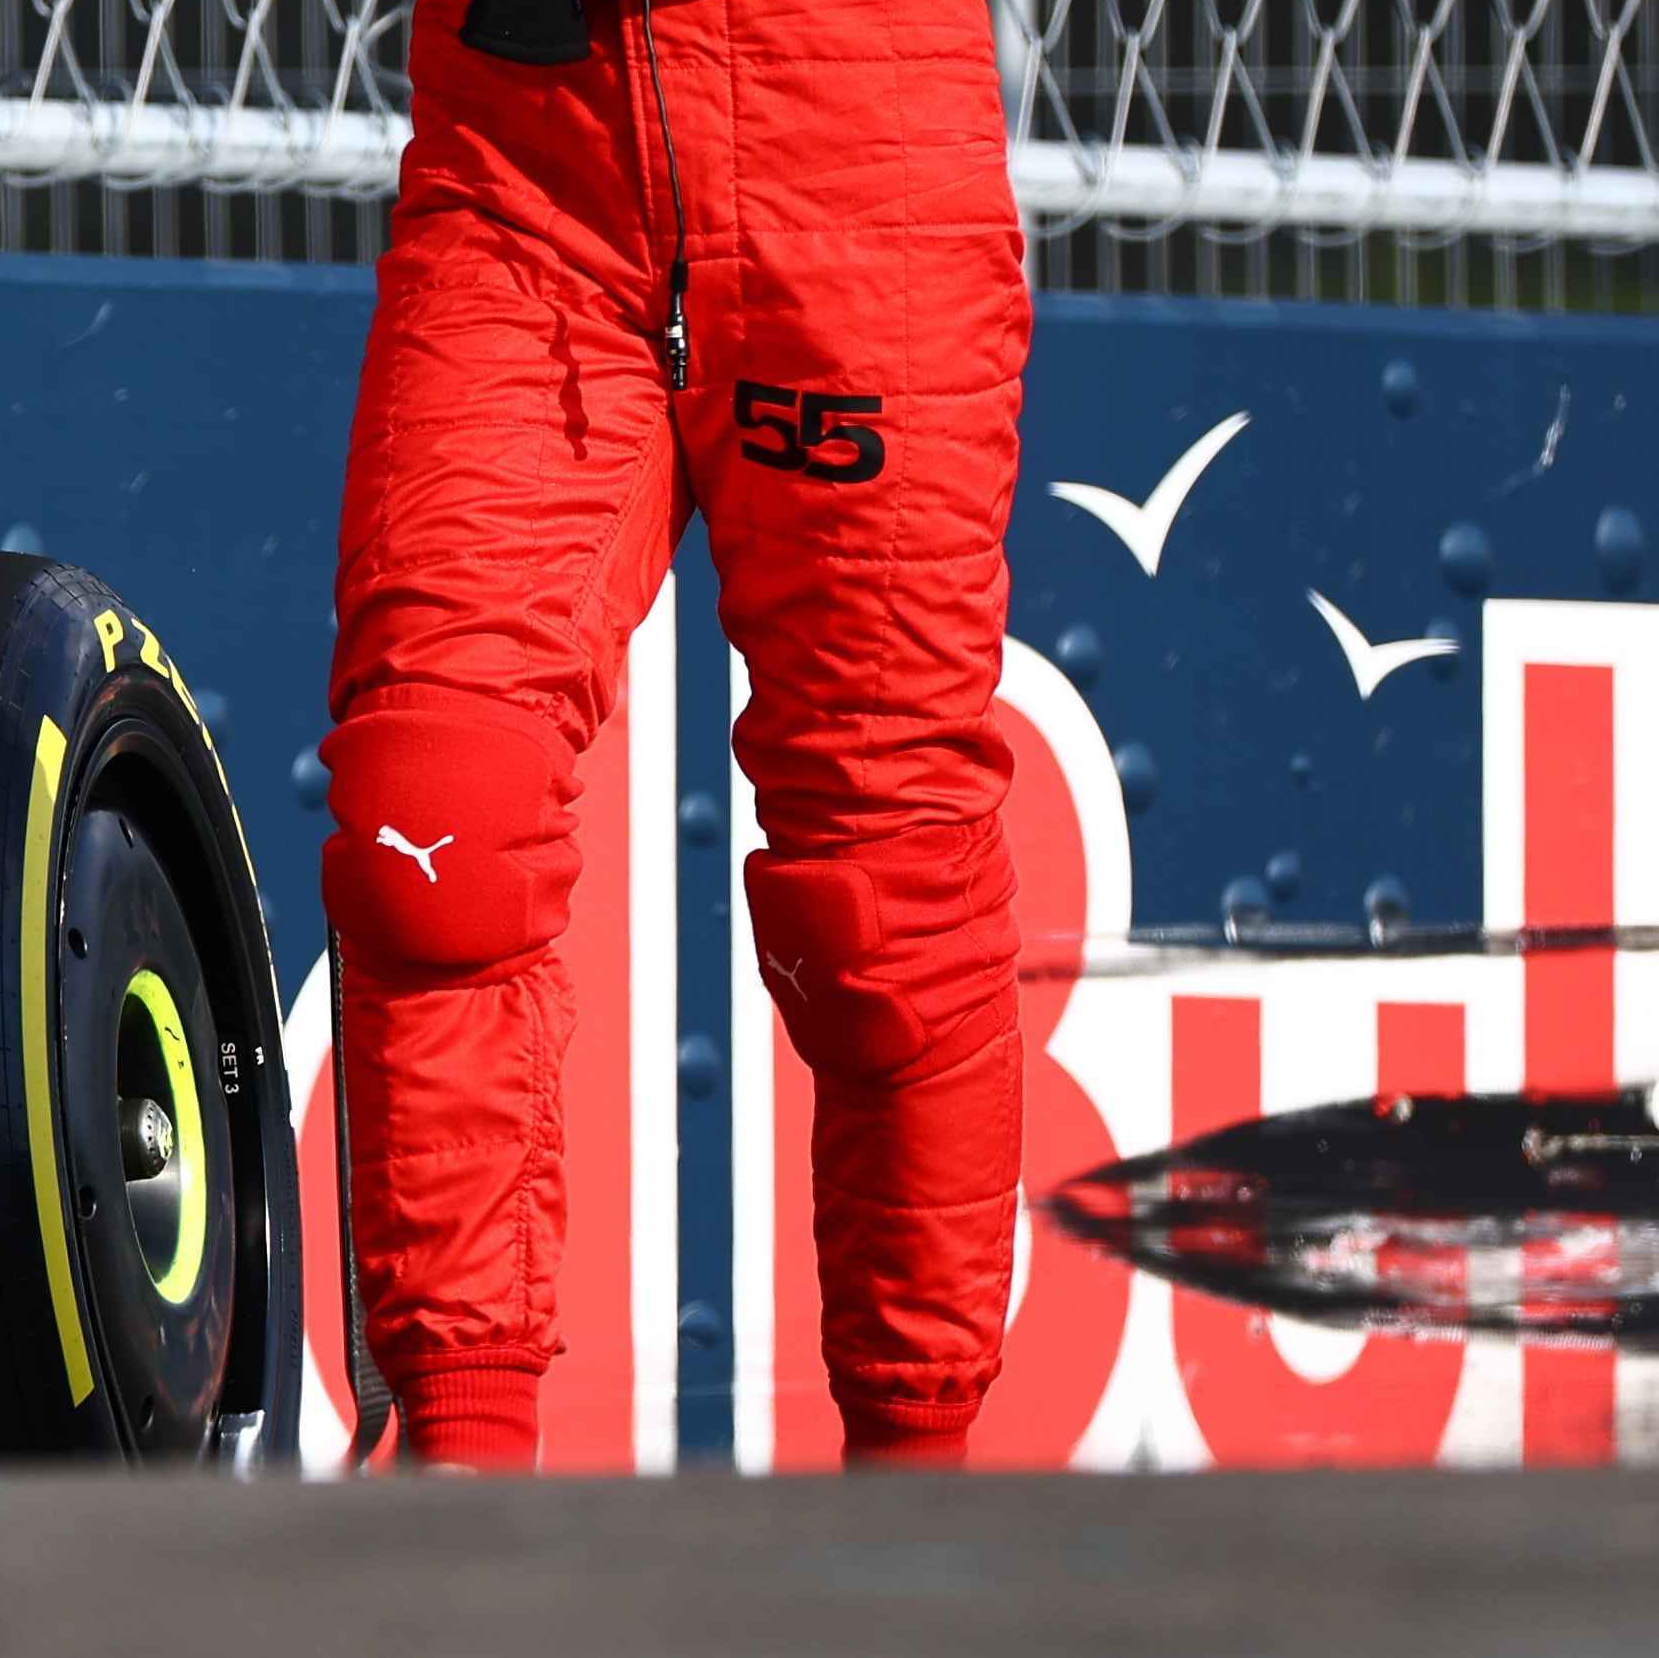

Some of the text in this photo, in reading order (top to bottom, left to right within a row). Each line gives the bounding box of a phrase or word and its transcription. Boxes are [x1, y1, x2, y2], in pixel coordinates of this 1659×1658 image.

[734, 378, 886, 484] 55
[93, 609, 124, 673] P
[220, 1042, 240, 1095] SET 3
